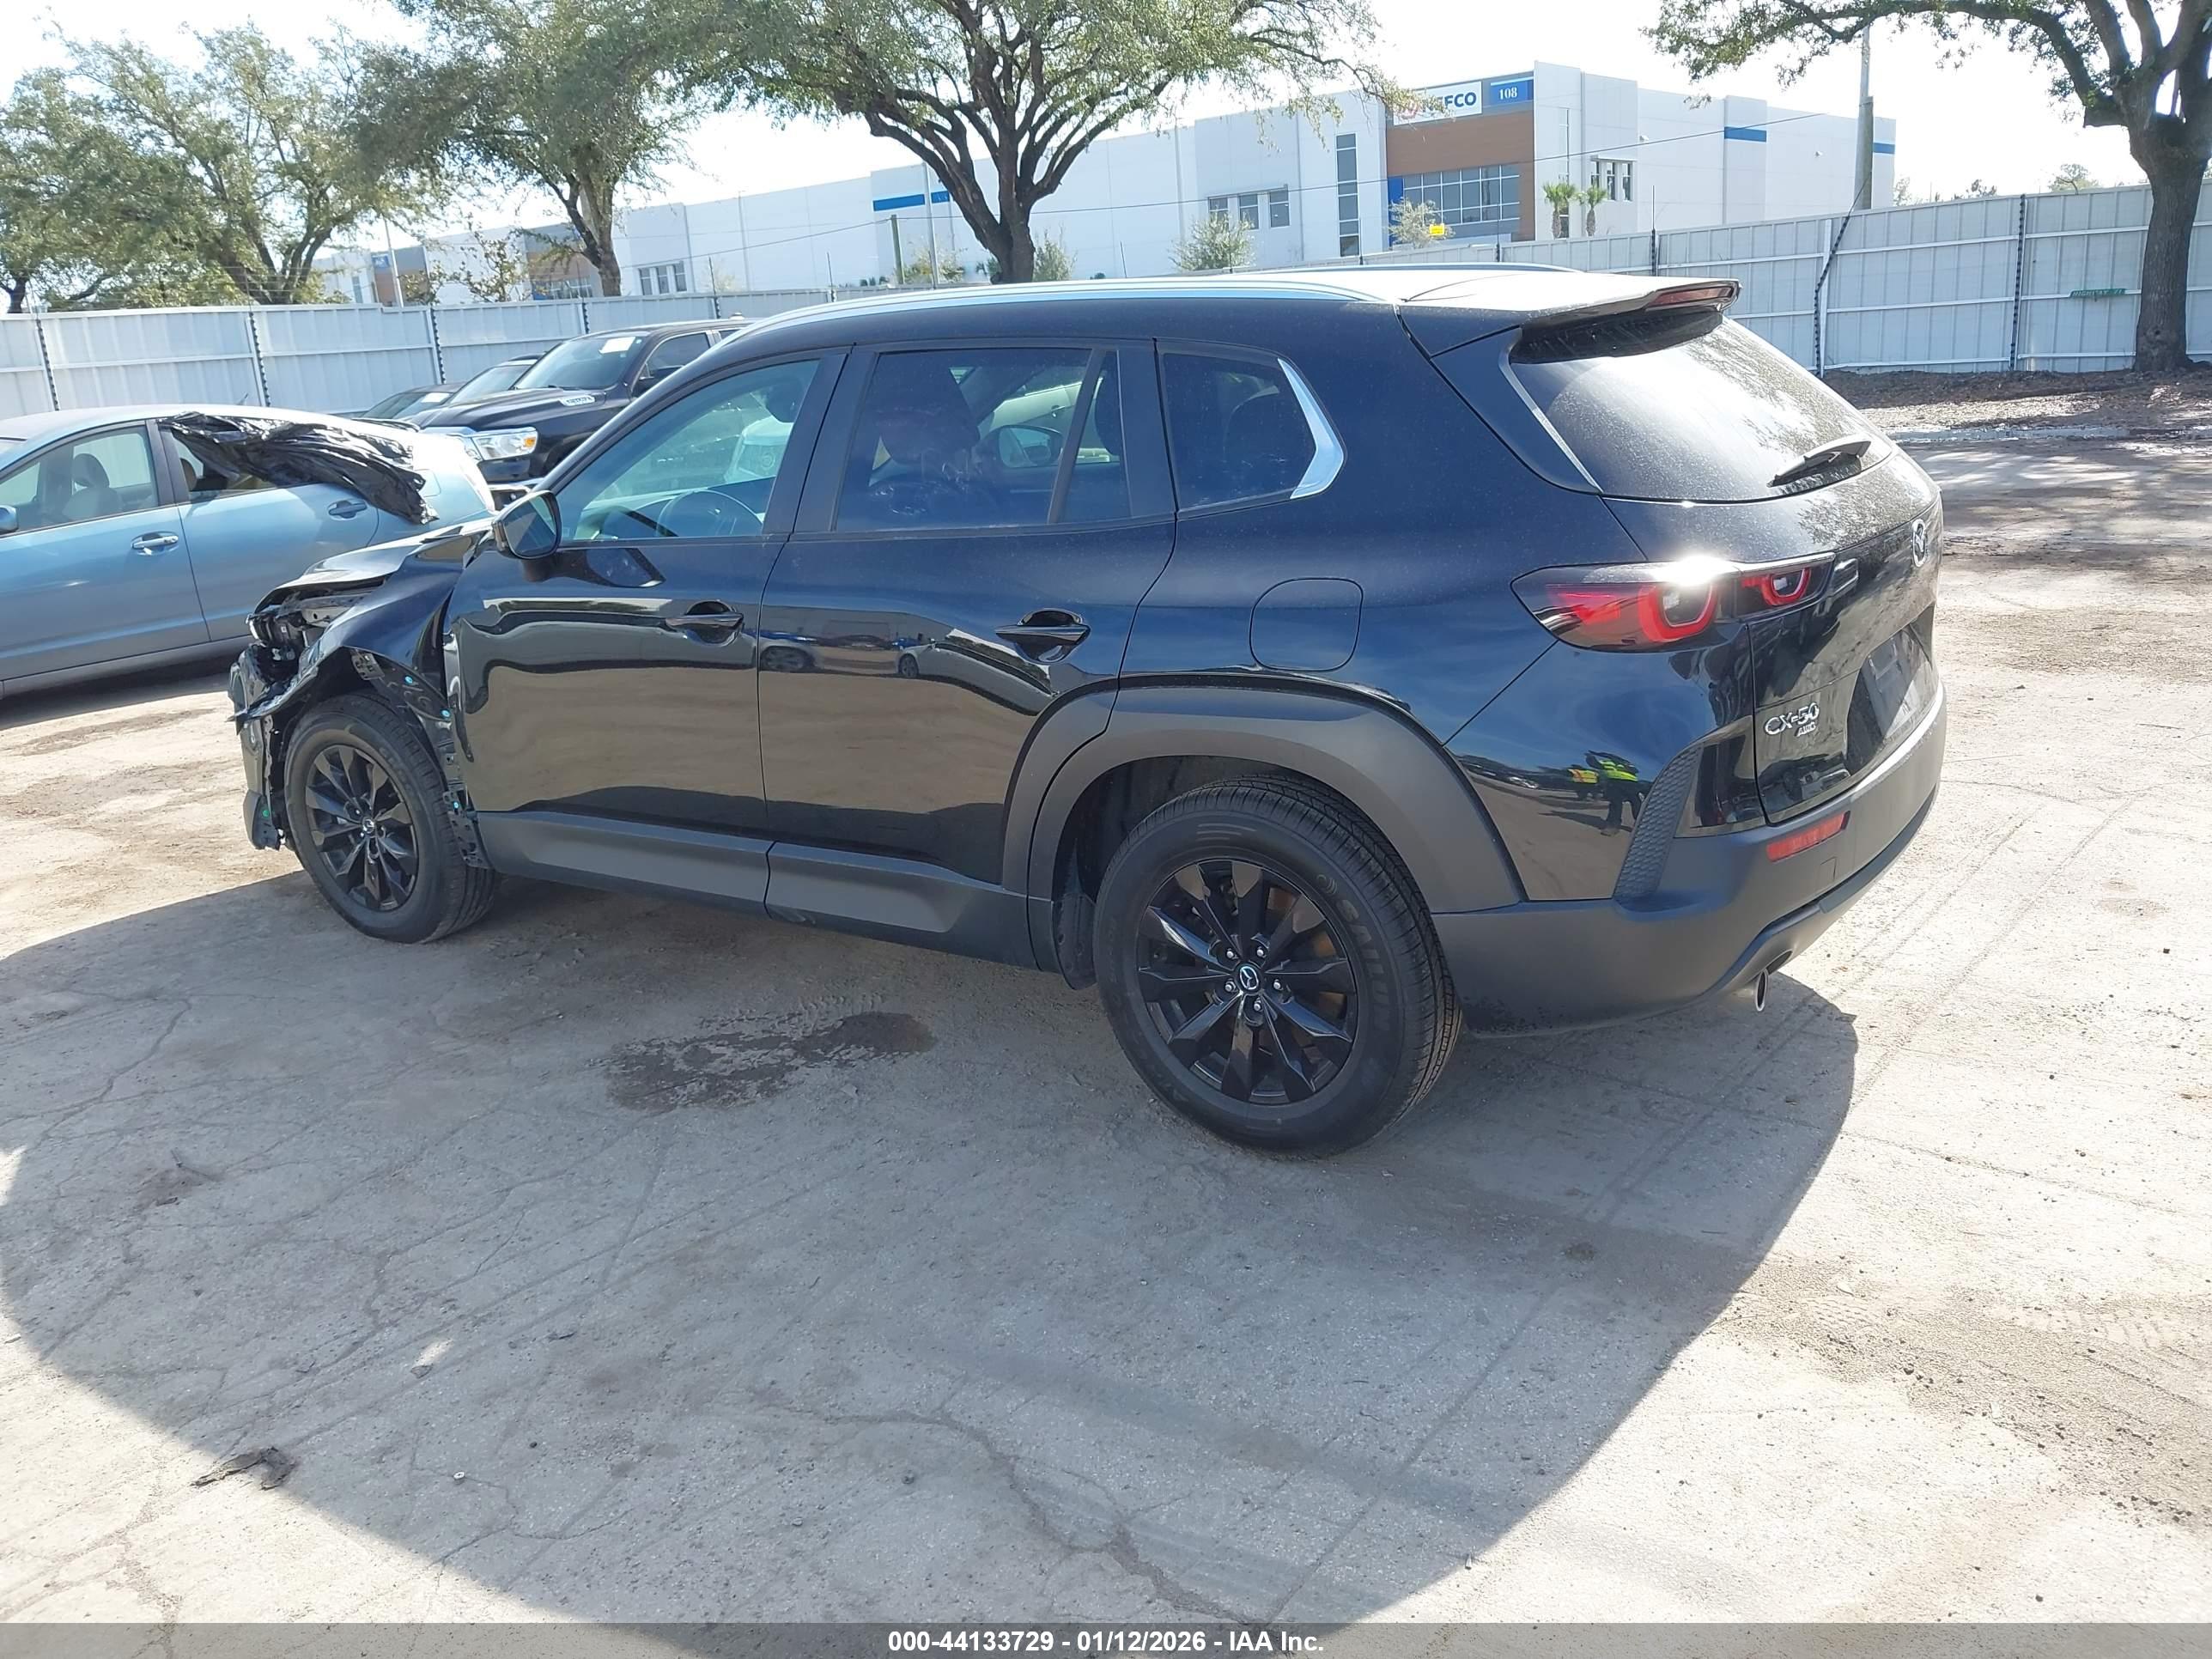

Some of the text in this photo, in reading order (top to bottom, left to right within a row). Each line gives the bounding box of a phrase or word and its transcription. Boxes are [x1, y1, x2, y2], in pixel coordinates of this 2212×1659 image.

[1499, 87, 1518, 100] 108
[1765, 702, 1820, 735] CX-50
[1796, 721, 1816, 738] AWD
